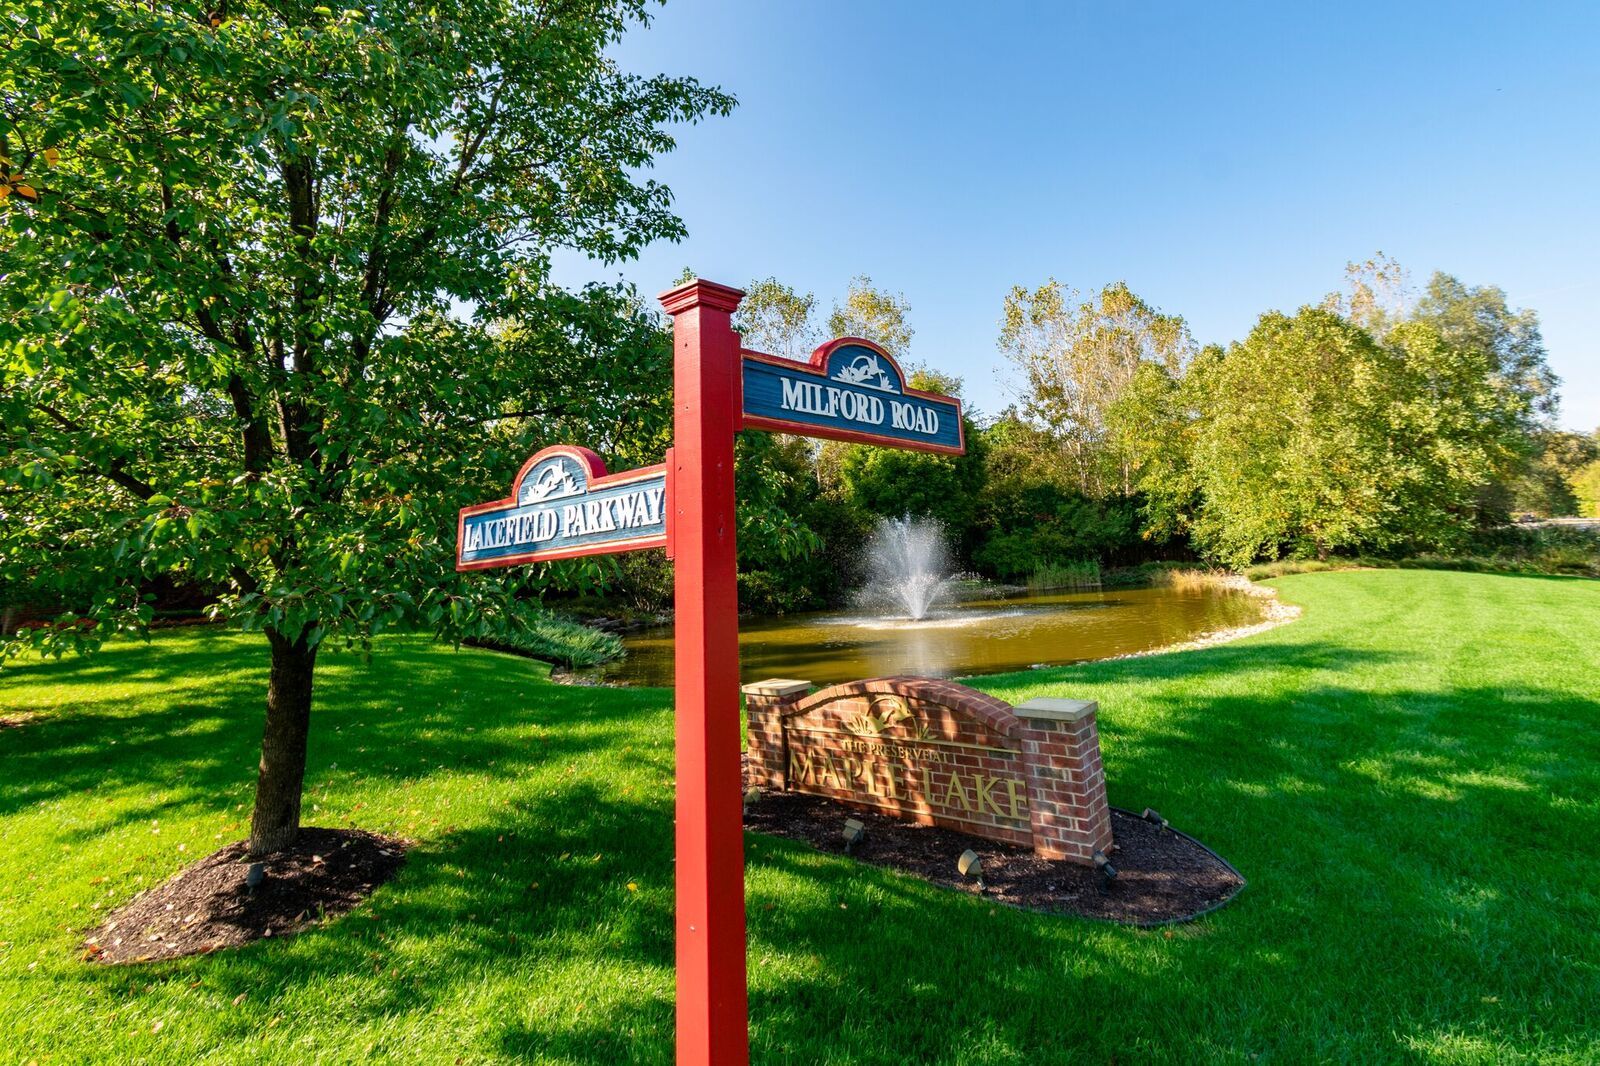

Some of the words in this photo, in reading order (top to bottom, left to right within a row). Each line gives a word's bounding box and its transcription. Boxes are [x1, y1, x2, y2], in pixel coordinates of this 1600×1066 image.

[780, 377, 884, 425] MILFORD
[889, 400, 939, 435] ROAD
[464, 508, 557, 552] LAKEFIELD
[563, 487, 664, 537] PARKWAY
[842, 740, 866, 752] THE
[868, 743, 930, 760] PRESERVE
[790, 750, 907, 800] MAPLE
[921, 767, 1031, 822] LAKE
